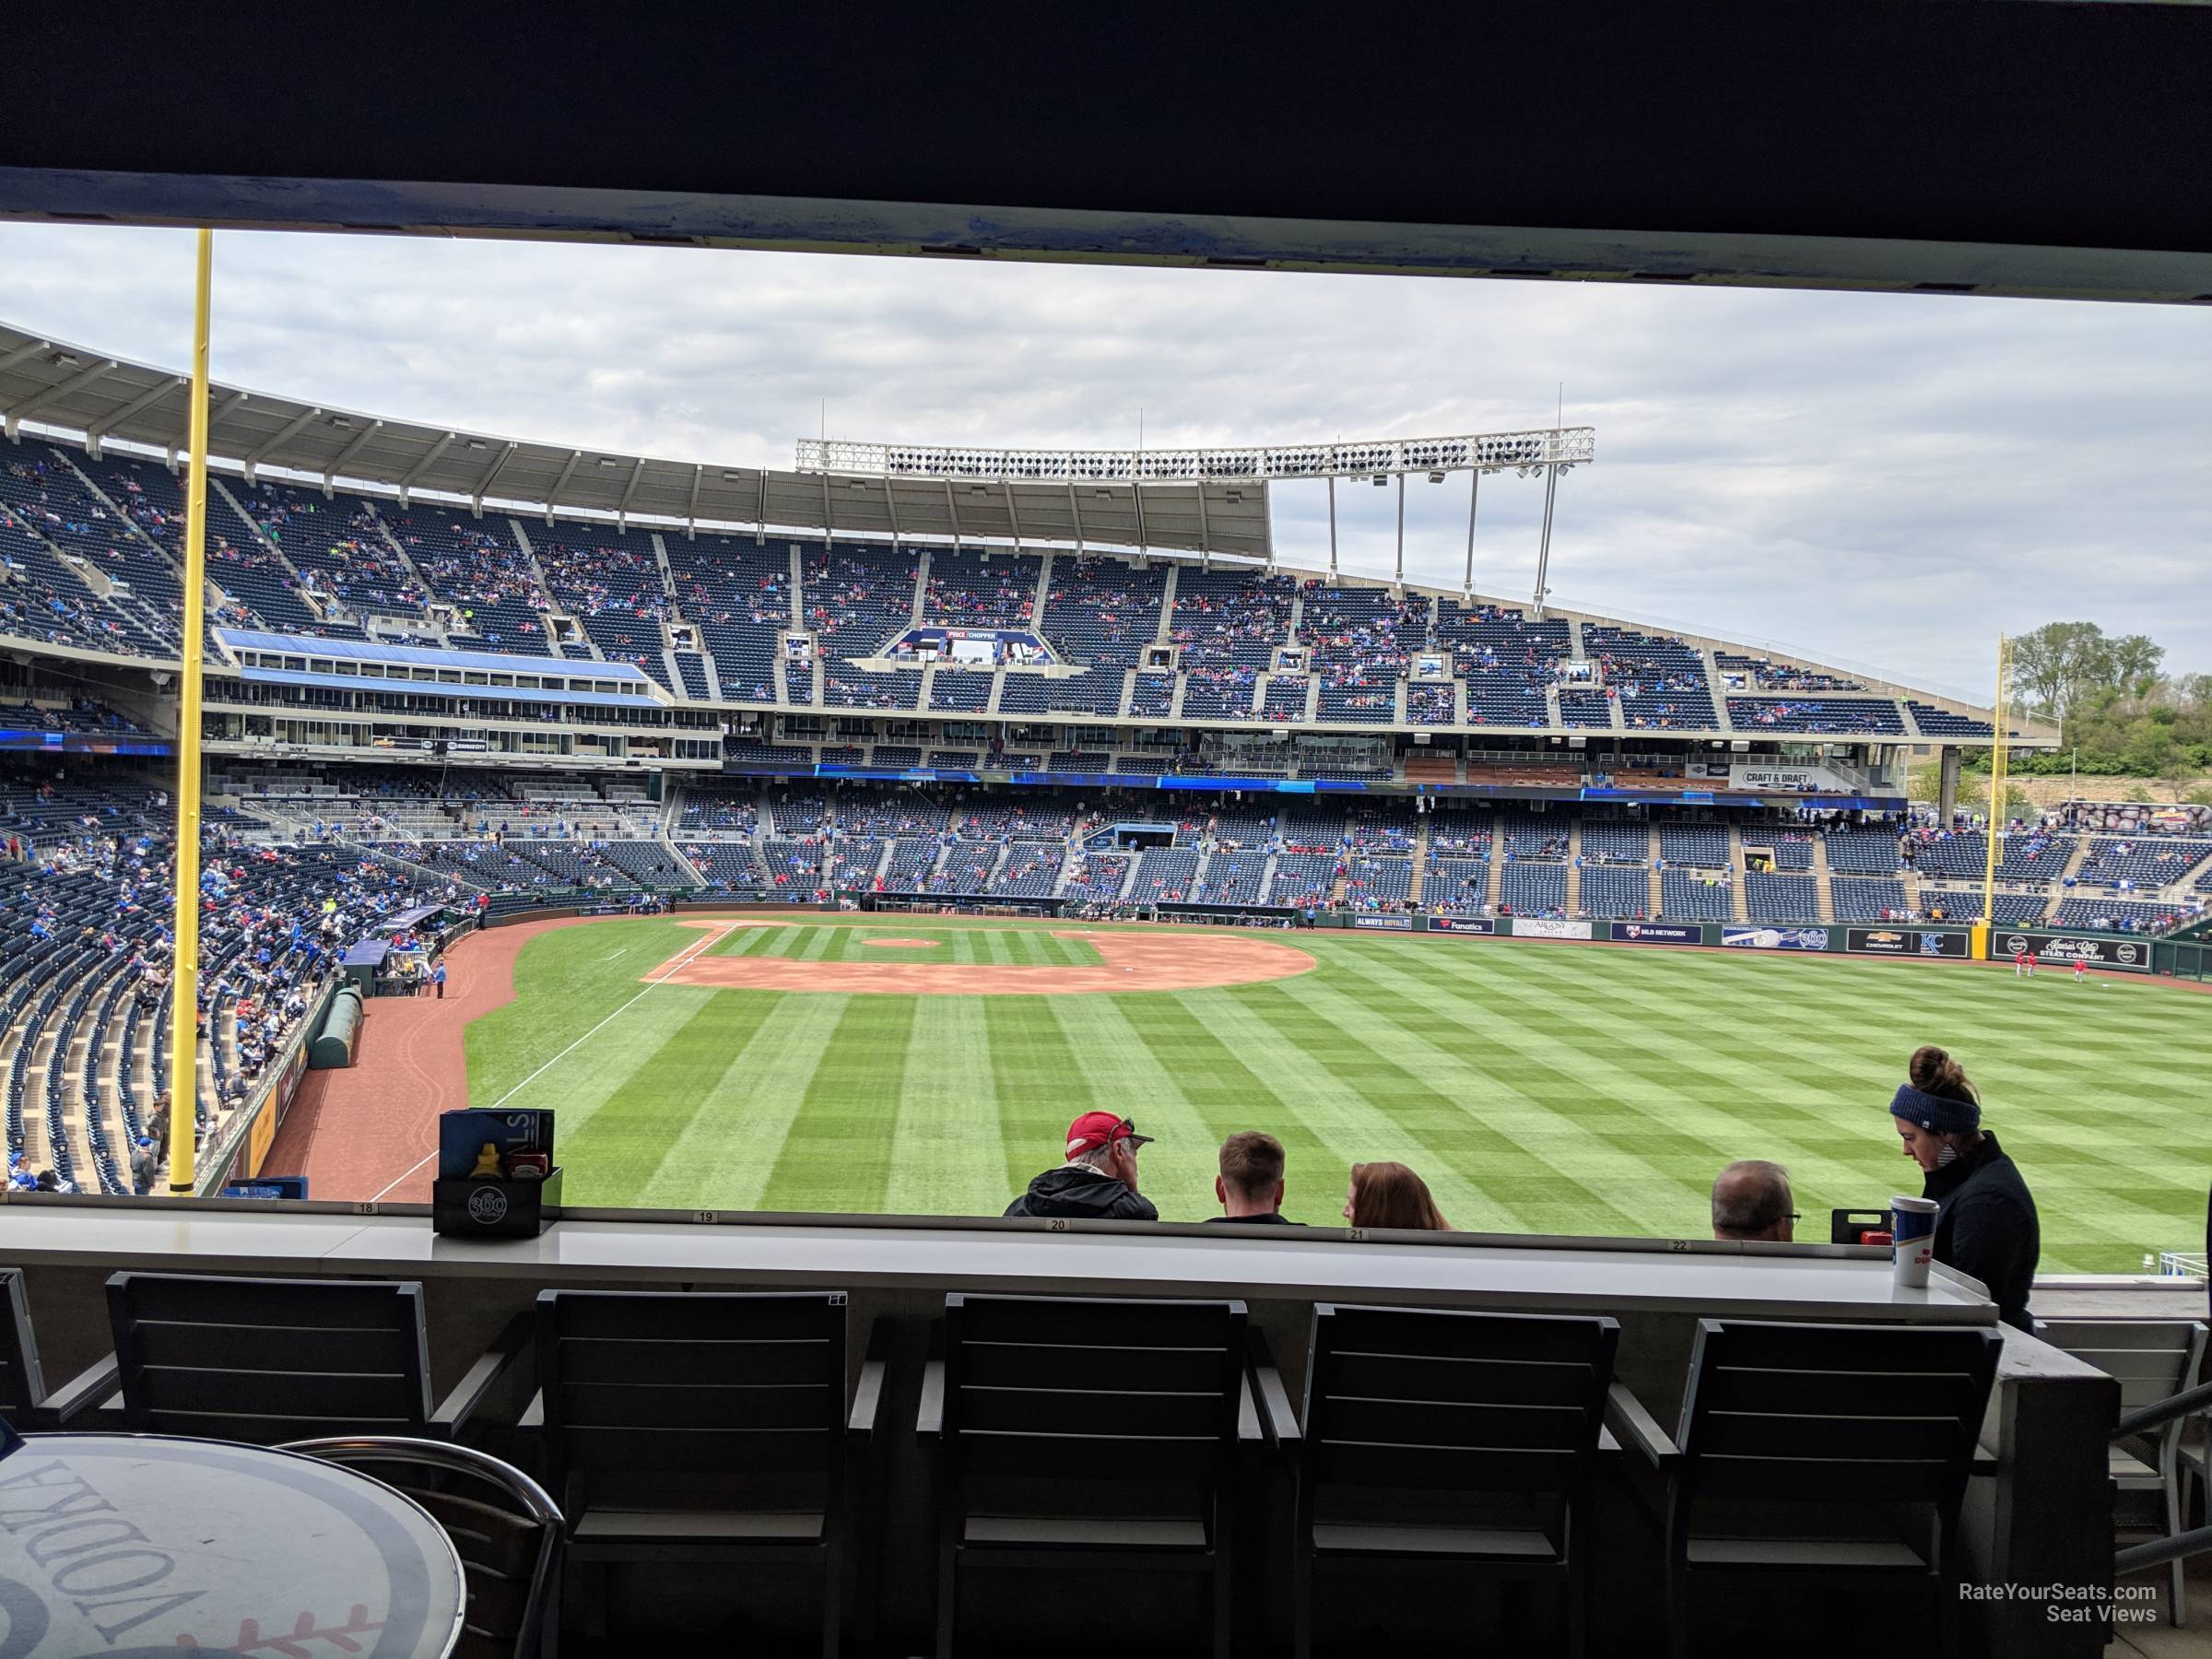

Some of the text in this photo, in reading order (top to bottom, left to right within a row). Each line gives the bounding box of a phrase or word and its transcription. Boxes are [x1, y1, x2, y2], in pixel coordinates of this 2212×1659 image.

[1747, 773, 1808, 783] CRAFT & DRAFT
[1357, 917, 1404, 927] ALWAYS ROYAL
[1451, 922, 1483, 931] Fanatics
[1534, 921, 1567, 931] ARGOSY
[1655, 929, 1687, 937] NETWORK
[1800, 930, 1827, 947] 360
[1920, 933, 1944, 955] KC
[2045, 938, 2100, 955] Kansas City
[2040, 949, 2106, 961] STEAK COMPANY
[359, 1202, 373, 1213] 18
[471, 1193, 504, 1217] 360
[700, 1211, 712, 1222] 19
[1052, 1219, 1065, 1230] 20
[1350, 1230, 1362, 1240] 21
[1673, 1241, 1687, 1251] 22
